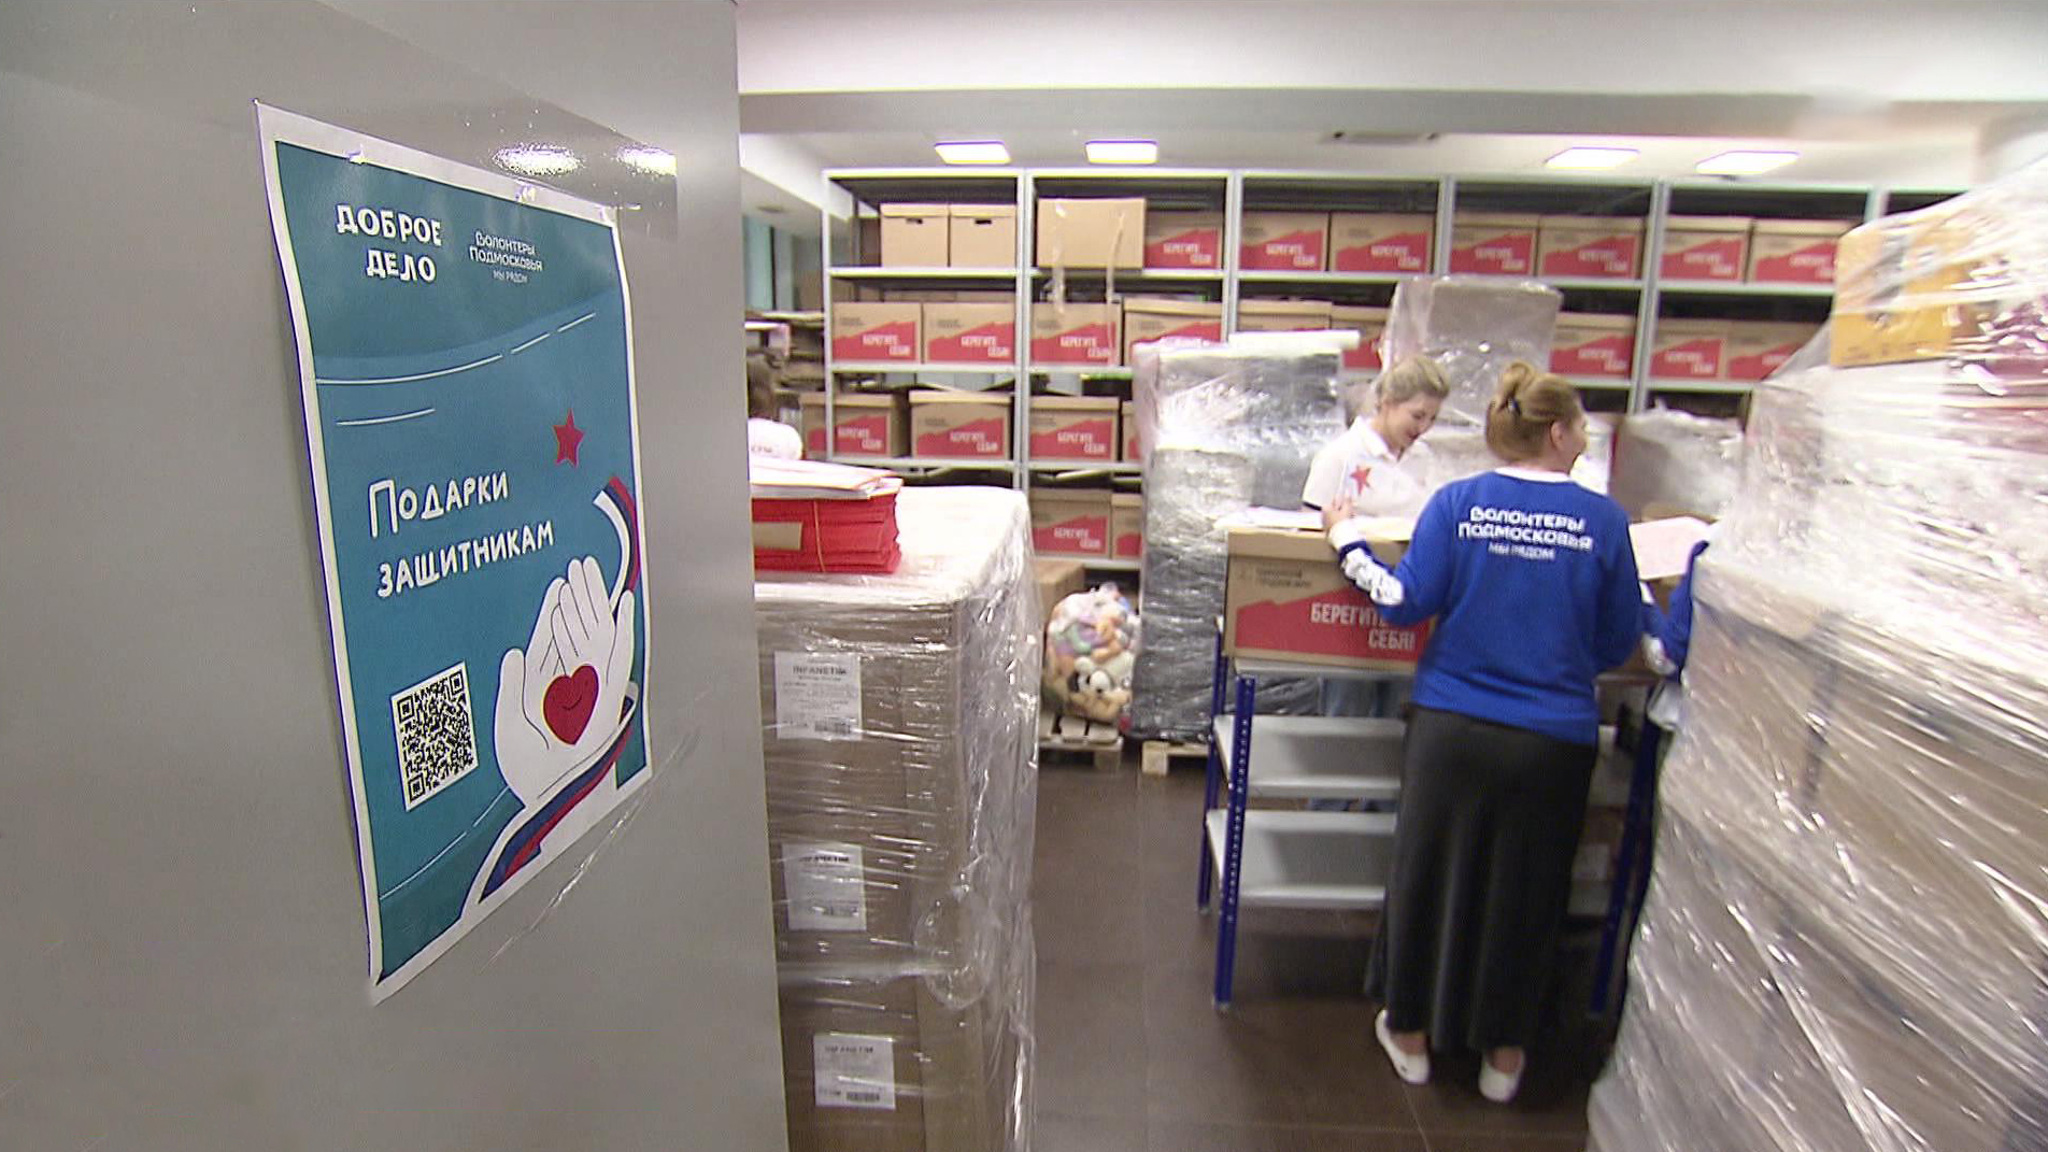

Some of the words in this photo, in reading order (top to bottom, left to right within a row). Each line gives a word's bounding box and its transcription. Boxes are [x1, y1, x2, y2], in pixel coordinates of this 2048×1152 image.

[336, 203, 442, 246] ДОБРОЕ
[365, 248, 437, 283] ДЕЛО
[369, 471, 509, 538] ПОДАРКИ
[1470, 505, 1586, 532] ВОЛОНТЕРЫ
[1458, 522, 1593, 550] ПОДМОСКОВЬЯ
[377, 519, 555, 598] ЗАЩИТНИКАМ
[1311, 602, 1387, 628] БЕРЕГИТ
[1368, 629, 1416, 651] СЕБЯ!
